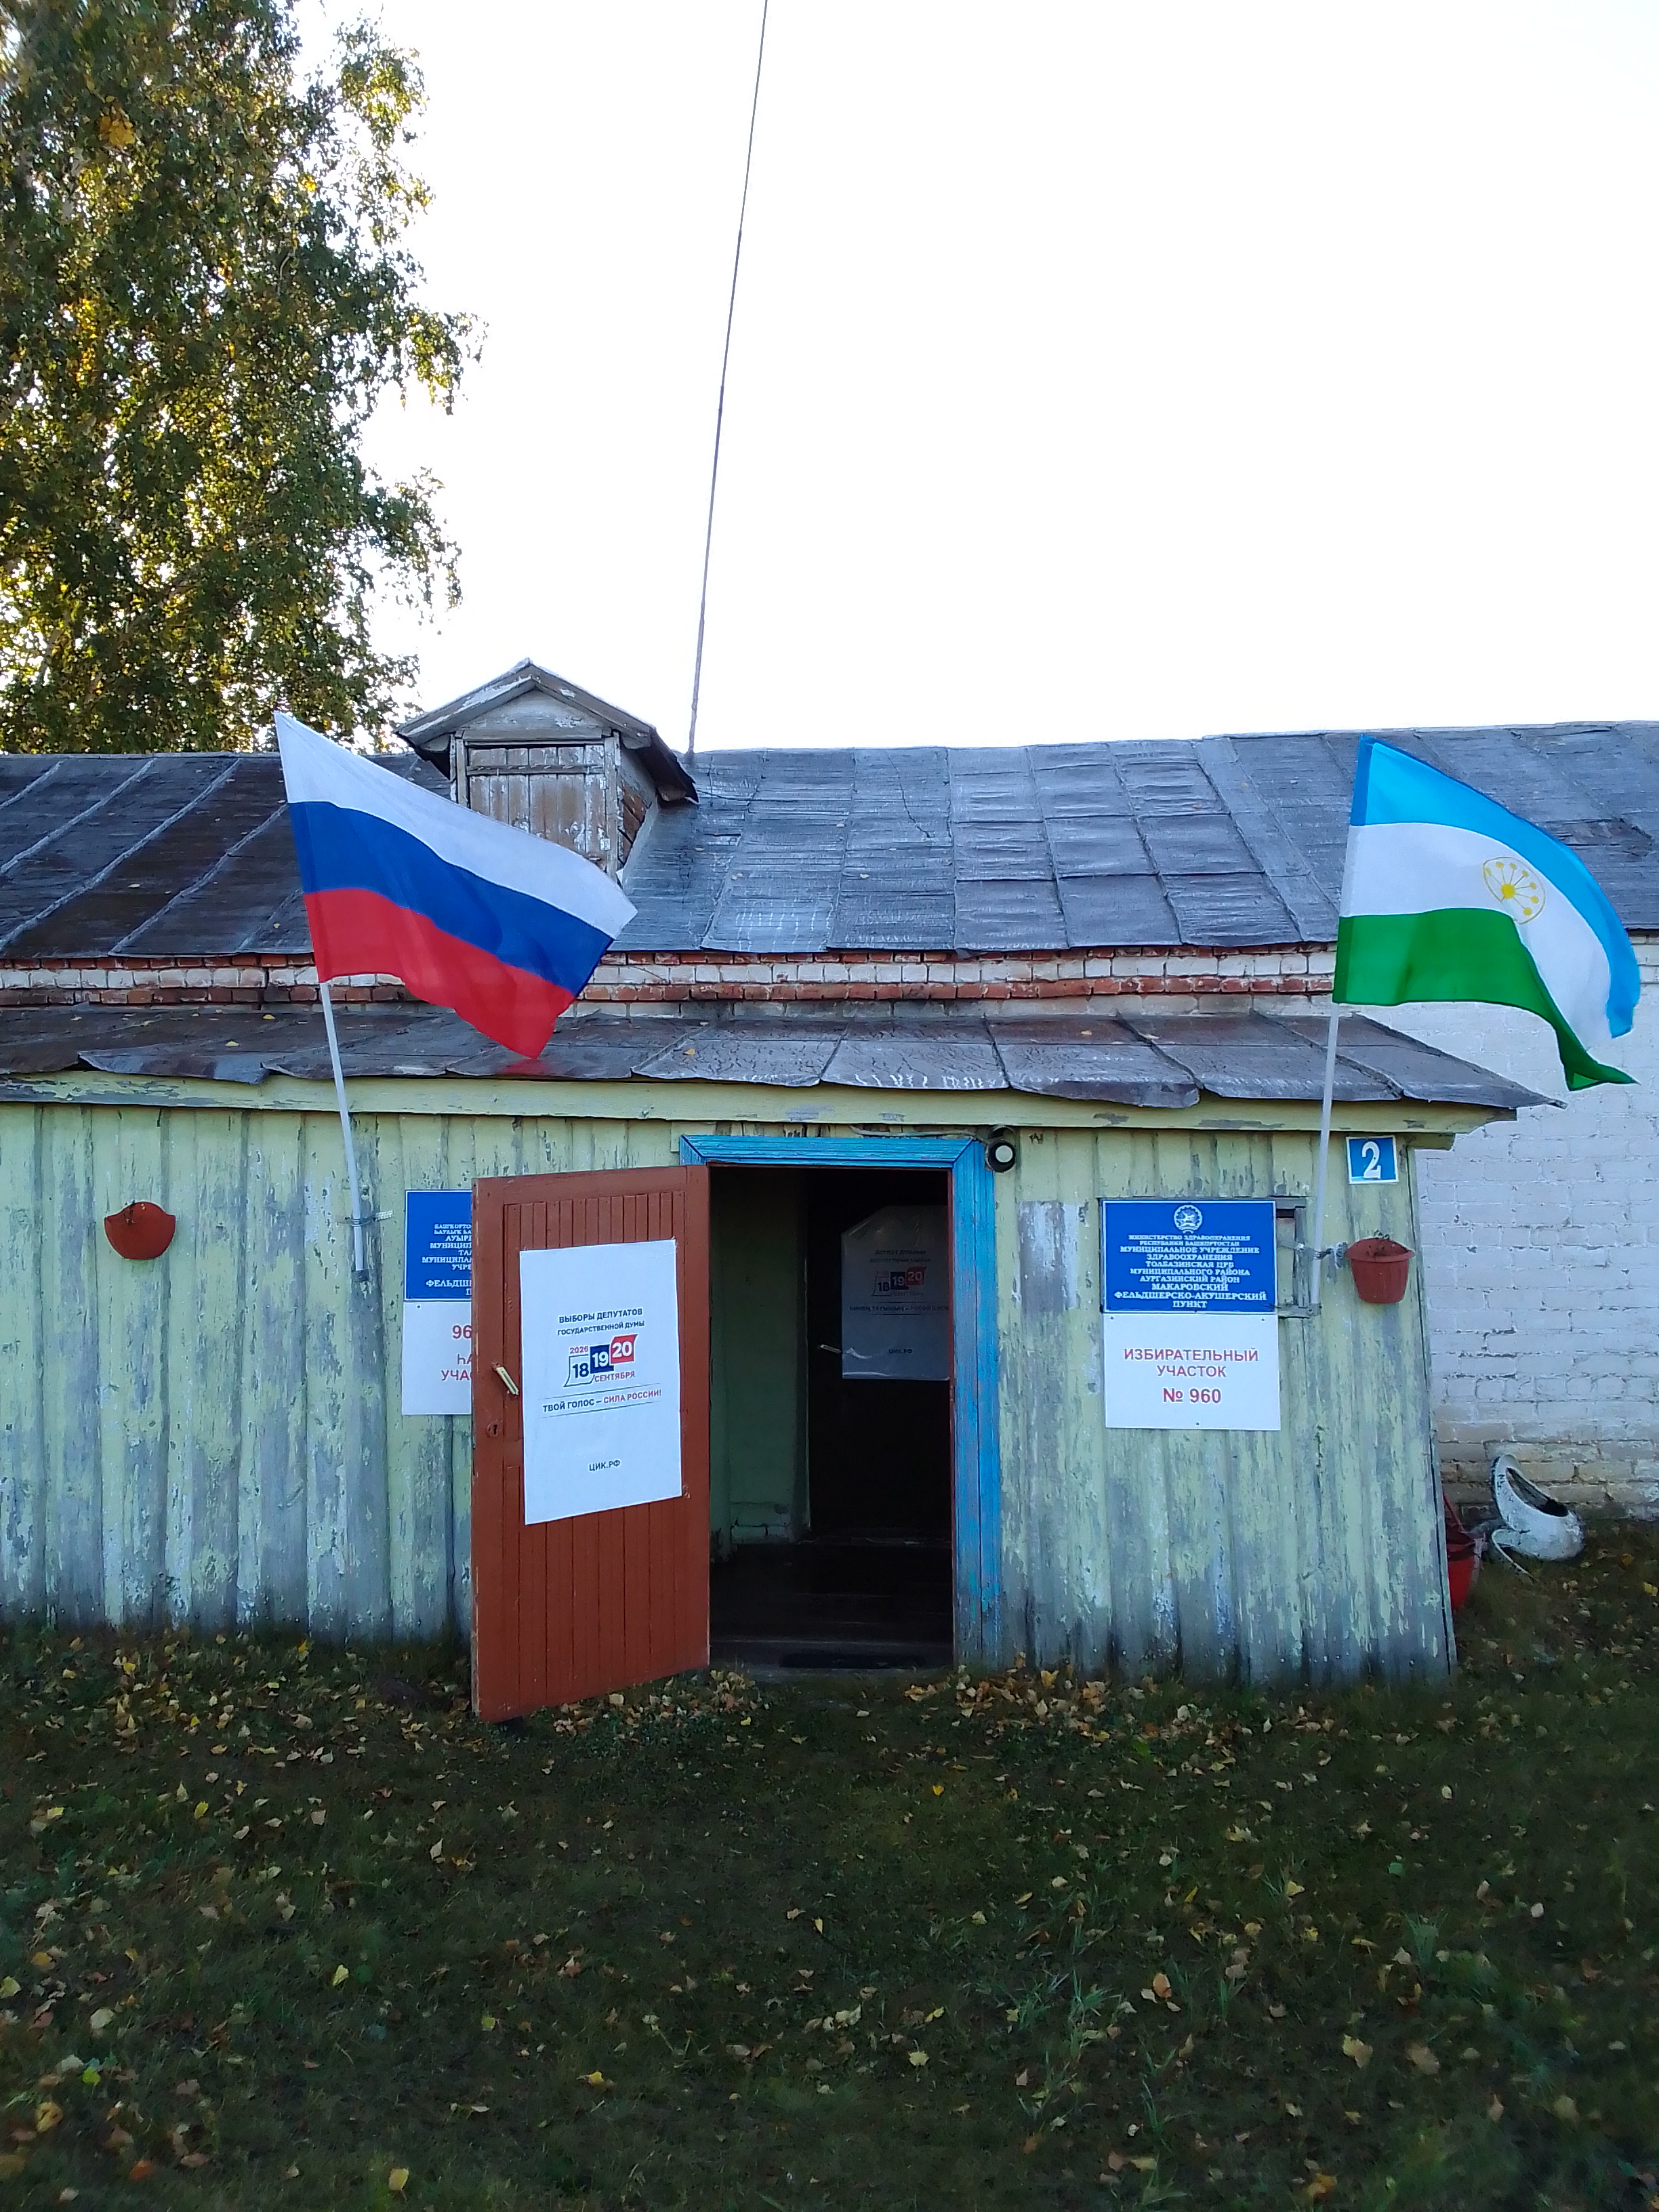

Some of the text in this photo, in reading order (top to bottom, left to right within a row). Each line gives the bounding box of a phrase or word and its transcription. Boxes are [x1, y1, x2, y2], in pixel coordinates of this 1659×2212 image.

[1361, 1141, 1382, 1179] 2
[1215, 1267, 1250, 1276] РАЙОНА
[892, 1276, 905, 1286] 19
[907, 1271, 922, 1282] 20
[1140, 1275, 1240, 1284] АУРГАЗИНСКИЙ РАЙОН
[1151, 1283, 1229, 1292] МАКАРОВСКИЙ
[1113, 1290, 1267, 1300] ФЕЛЬДШЕРСКО-АКУШЕРСКИЙ
[1172, 1300, 1208, 1309] ПУНКТ
[559, 1308, 643, 1324] ВЫБОРЫ ДЕПУТАТОВ
[452, 1325, 472, 1340] 96
[557, 1320, 645, 1336] ГОСУДАРСТВЕННОЙ ДУМЫ
[457, 1353, 472, 1365] ҺА
[573, 1340, 632, 1378] 18 19 20
[1124, 1347, 1259, 1361] ИЗБИРАТЕЛЬНЫЙ
[441, 1370, 472, 1381] УЧА
[594, 1370, 635, 1382] СЕНТЯБРЯ
[1157, 1365, 1227, 1377] УЧАСТОК
[542, 1400, 565, 1412] ТВОЙ
[567, 1398, 595, 1410] ГОЛОС
[604, 1395, 625, 1404] СИЛА
[628, 1389, 662, 1401] РОССИИ!
[1163, 1388, 1221, 1404] № 960
[588, 1459, 621, 1472] ЦИК.РФ
